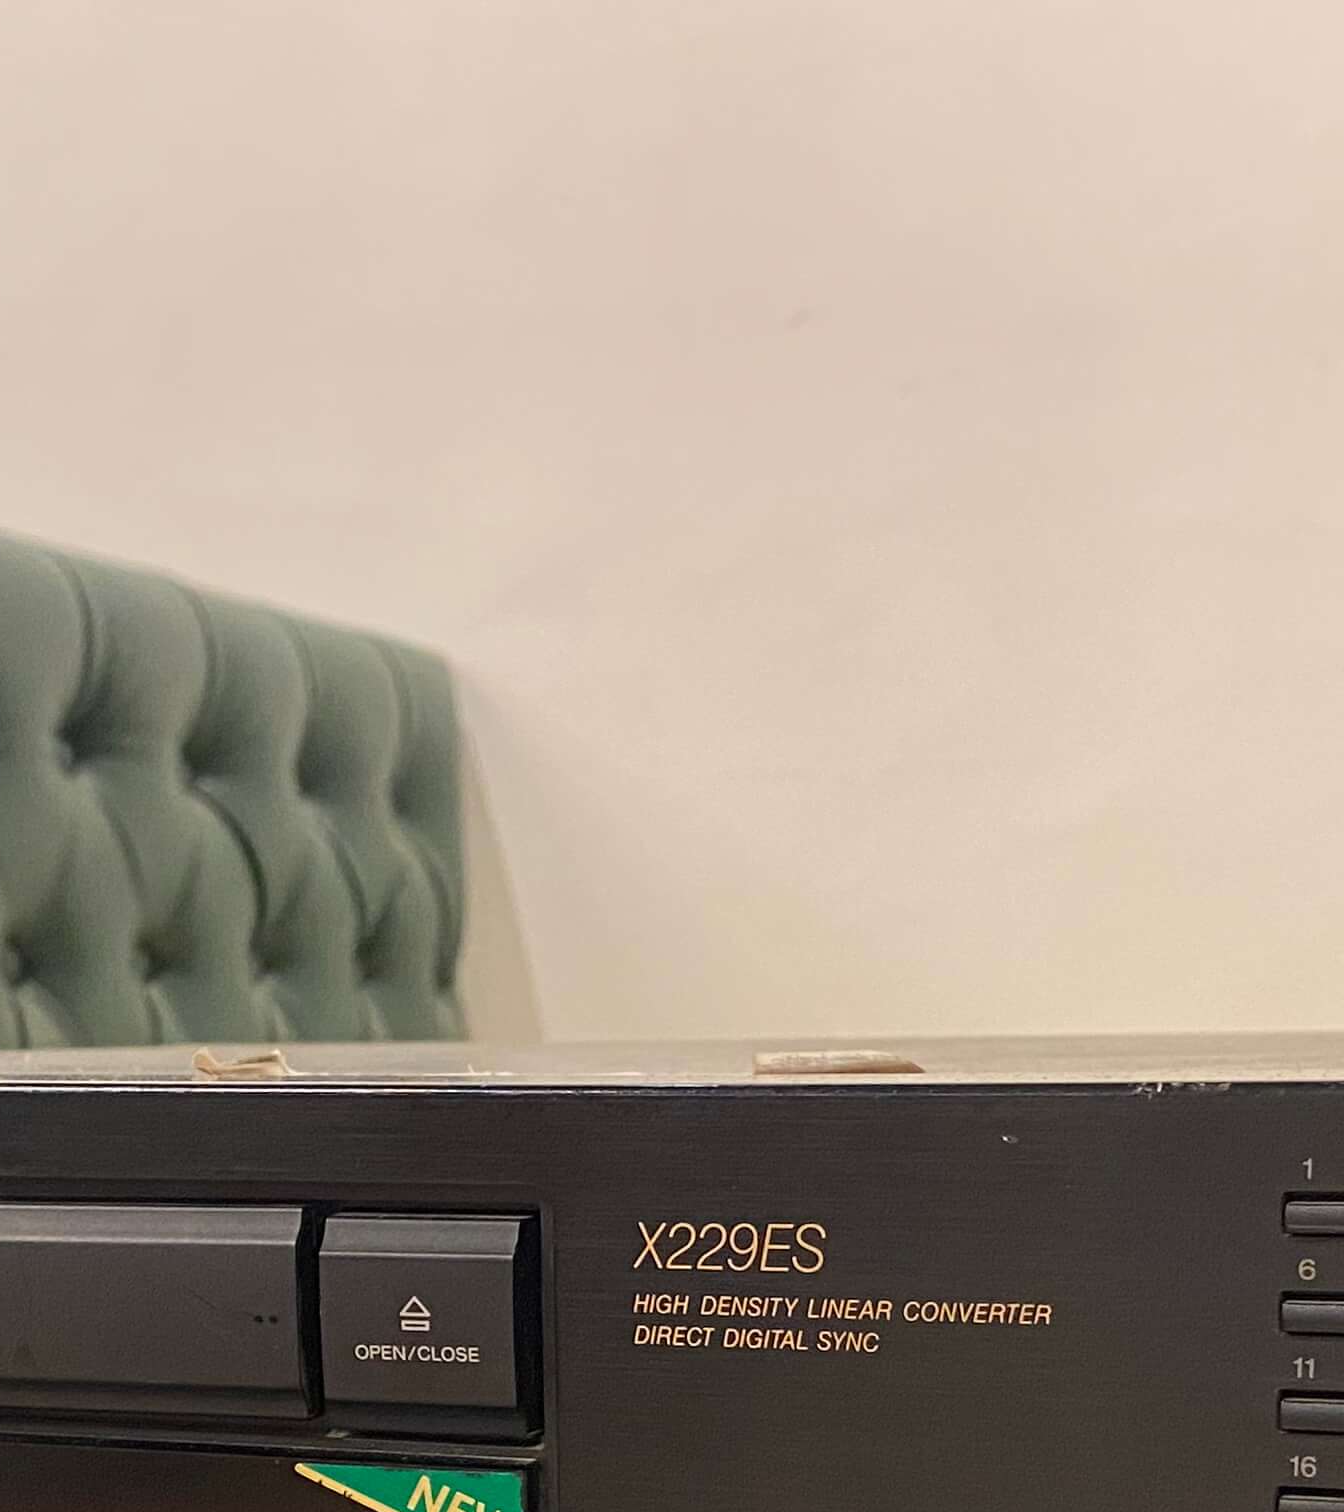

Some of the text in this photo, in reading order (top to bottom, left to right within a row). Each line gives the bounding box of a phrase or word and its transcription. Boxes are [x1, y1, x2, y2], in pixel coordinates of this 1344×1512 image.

[1302, 1160, 1313, 1180] 1
[633, 1222, 827, 1273] X229ES
[1298, 1259, 1316, 1280] 6
[633, 1294, 1052, 1325] HIGH DENSITY LINEAR CONVERTER
[634, 1325, 880, 1353] DIRECT DIGITAL SYNC
[354, 1344, 480, 1363] OPEN/CLOSE
[1293, 1358, 1316, 1379] 11
[1290, 1456, 1317, 1478] 16
